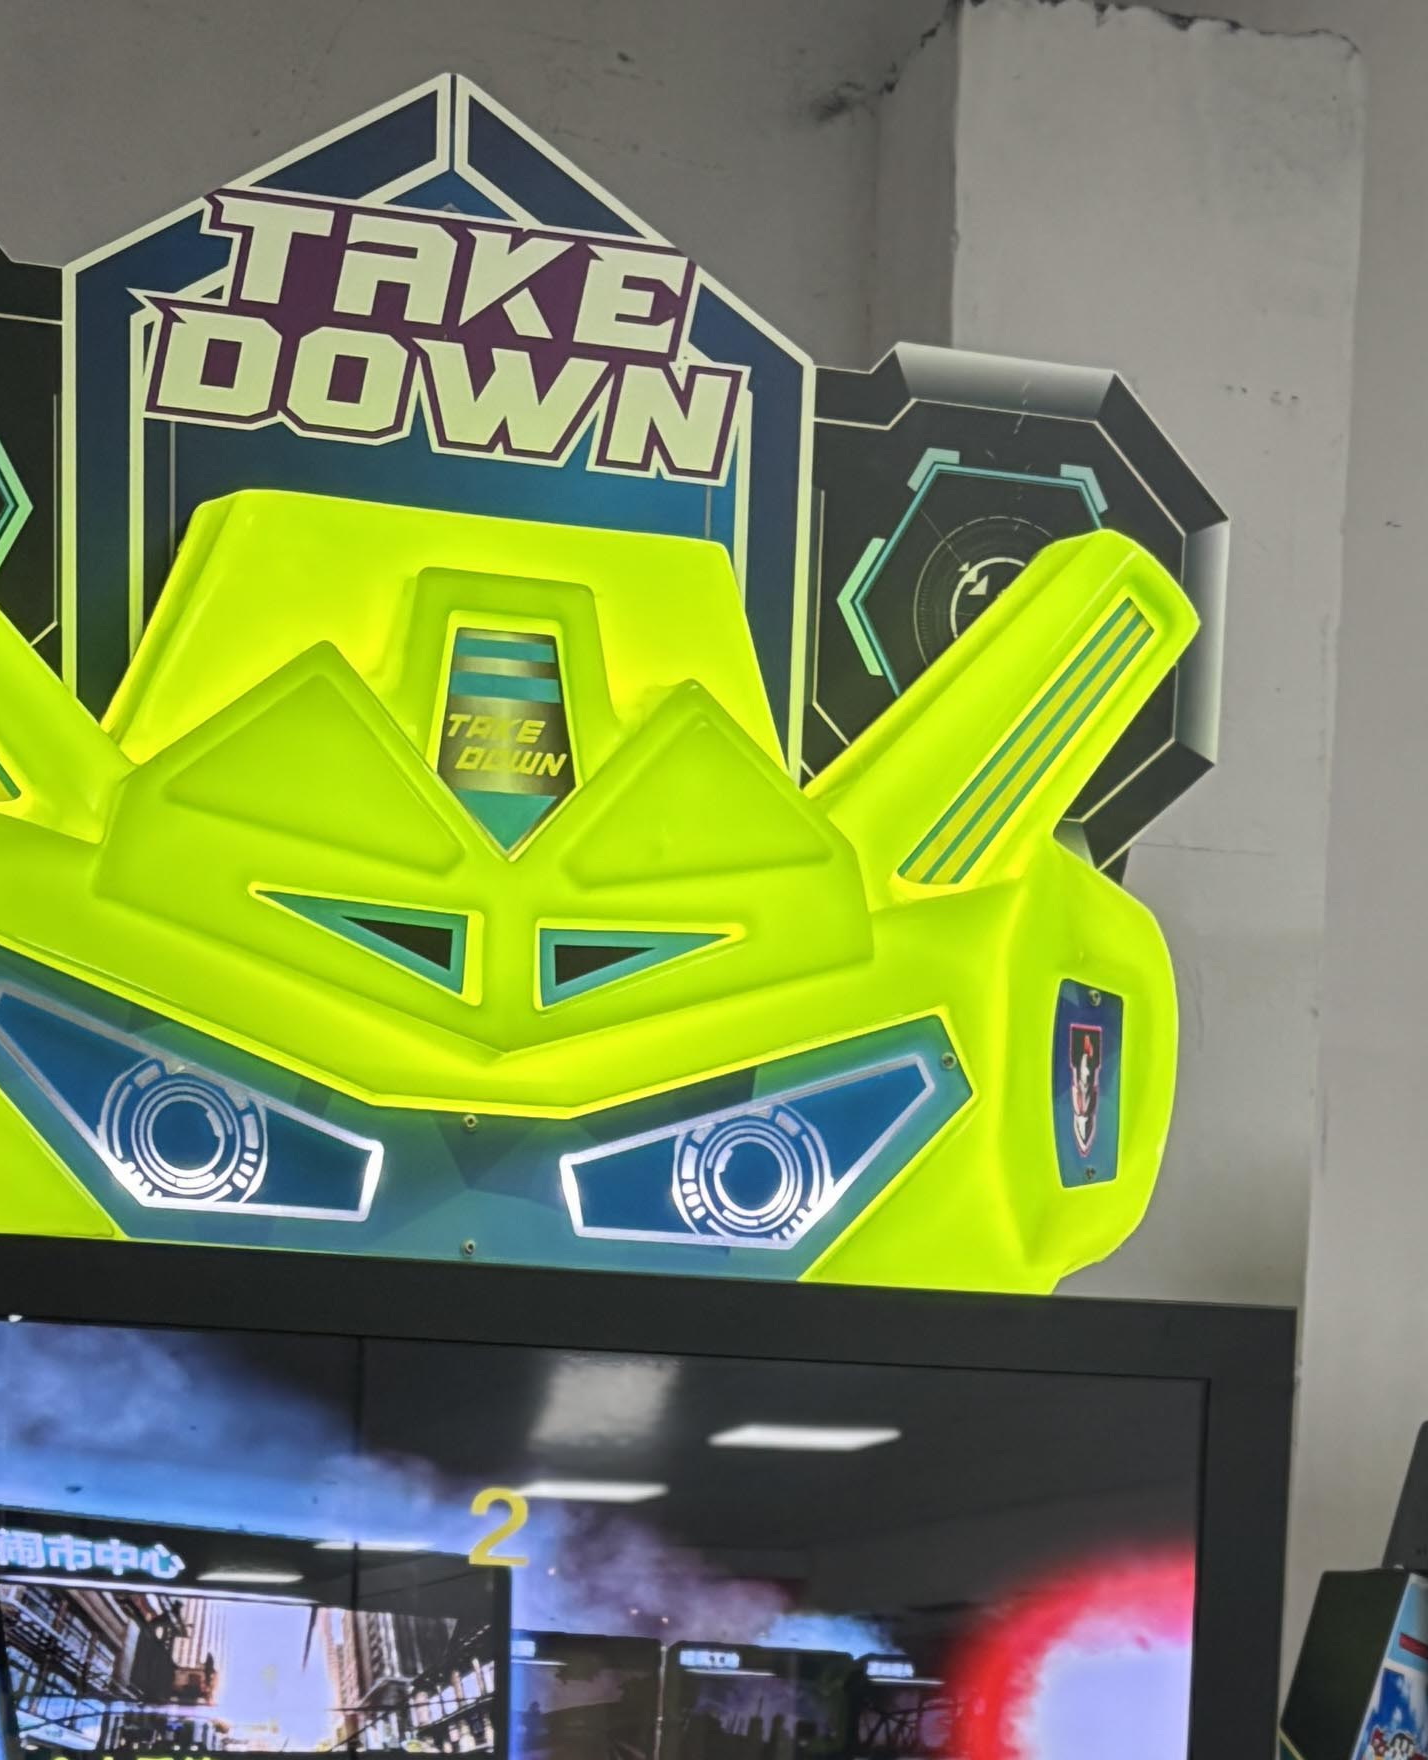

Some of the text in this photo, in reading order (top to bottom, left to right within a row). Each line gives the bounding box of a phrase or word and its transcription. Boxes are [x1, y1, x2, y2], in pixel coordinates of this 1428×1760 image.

[215, 195, 688, 354] TAKE
[156, 307, 734, 472] DOWN
[447, 713, 546, 743] TAKE
[455, 746, 567, 776] DOWN
[468, 1487, 529, 1567] 2
